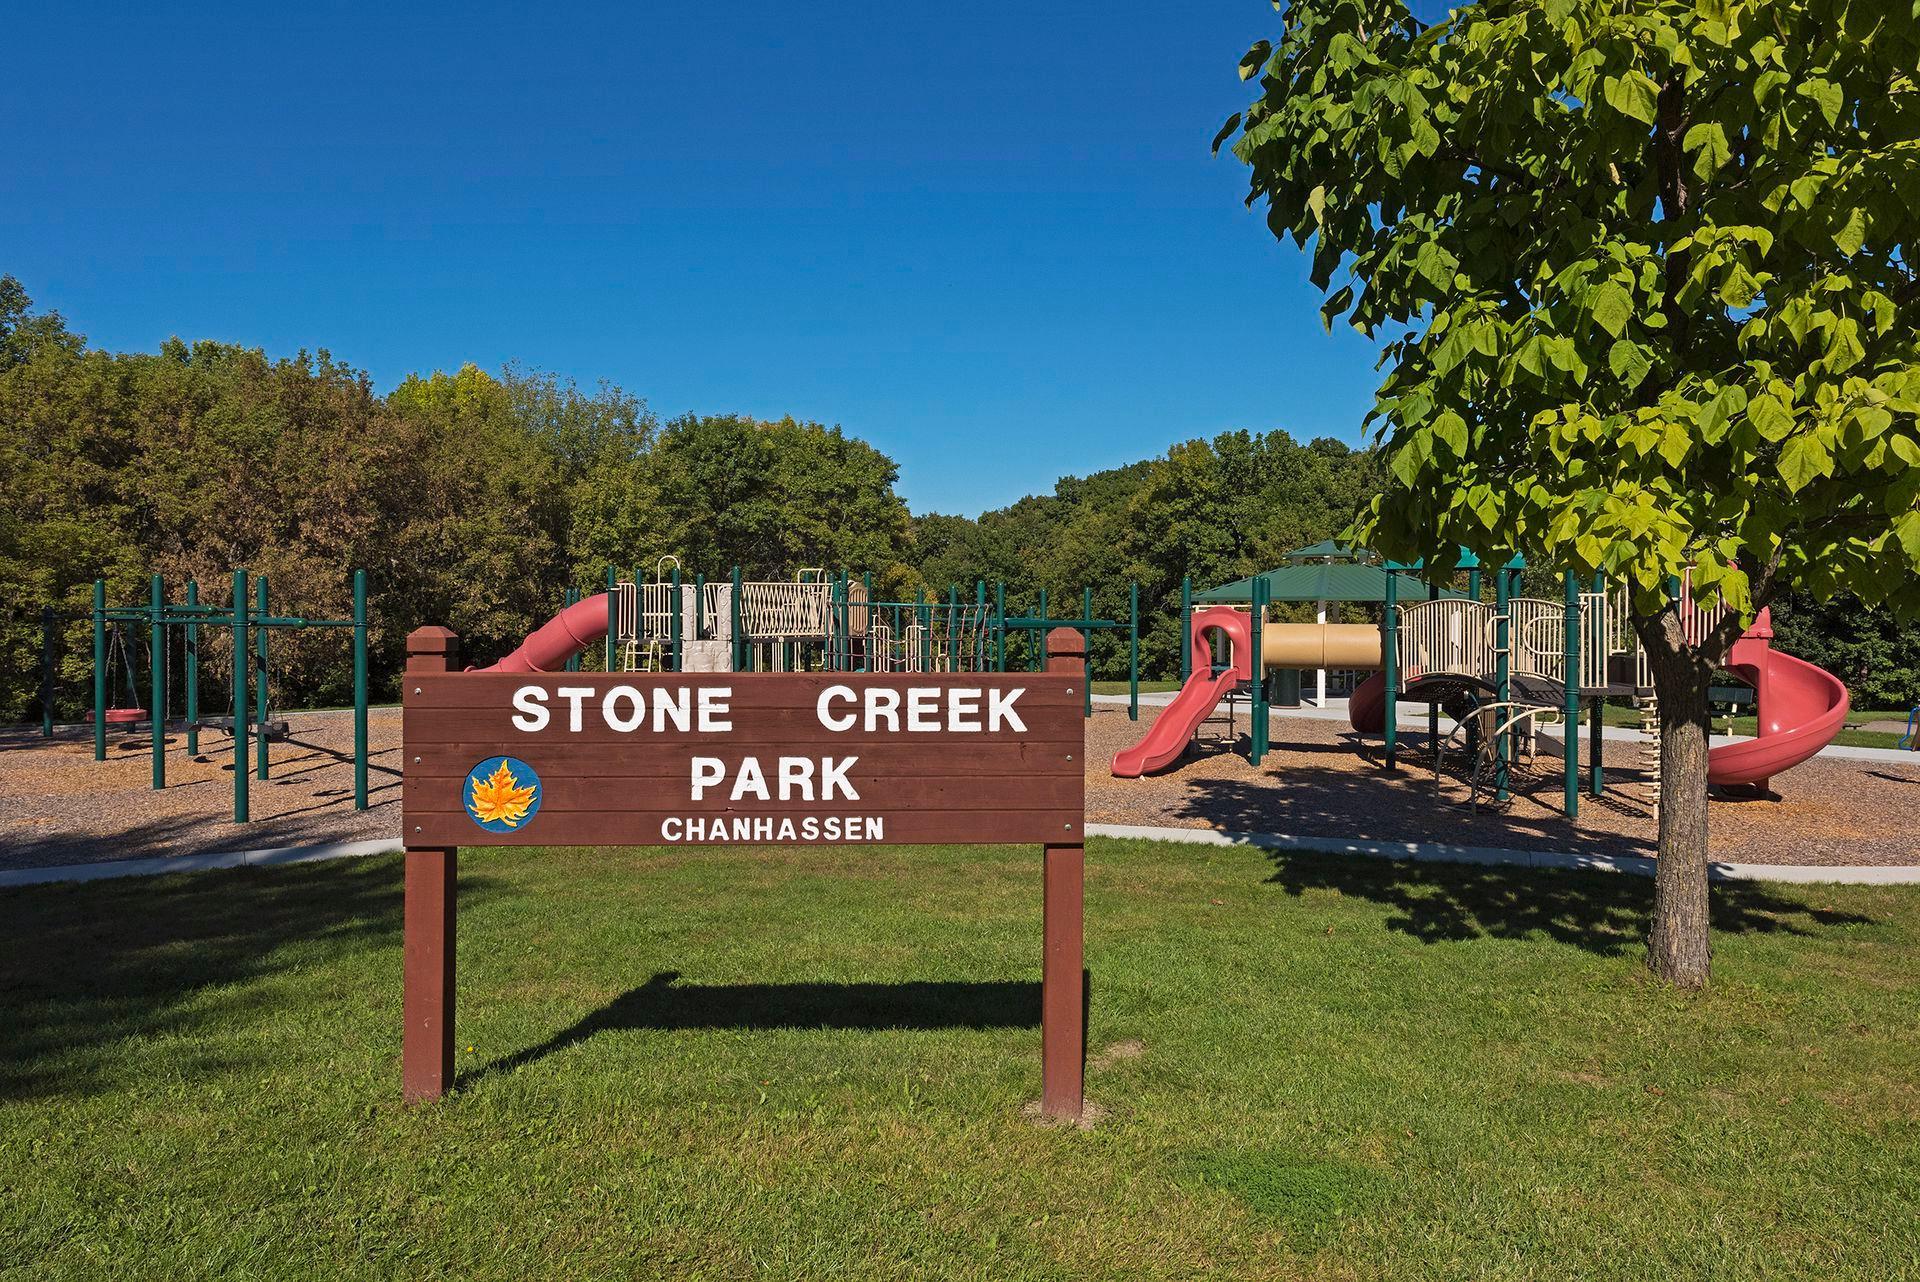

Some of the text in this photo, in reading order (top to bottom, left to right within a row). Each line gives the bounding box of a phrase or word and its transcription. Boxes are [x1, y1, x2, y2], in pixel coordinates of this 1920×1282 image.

[511, 684, 1028, 733] STONE CREEK
[691, 756, 861, 801] PARK
[661, 816, 884, 842] CHANHASSEN
